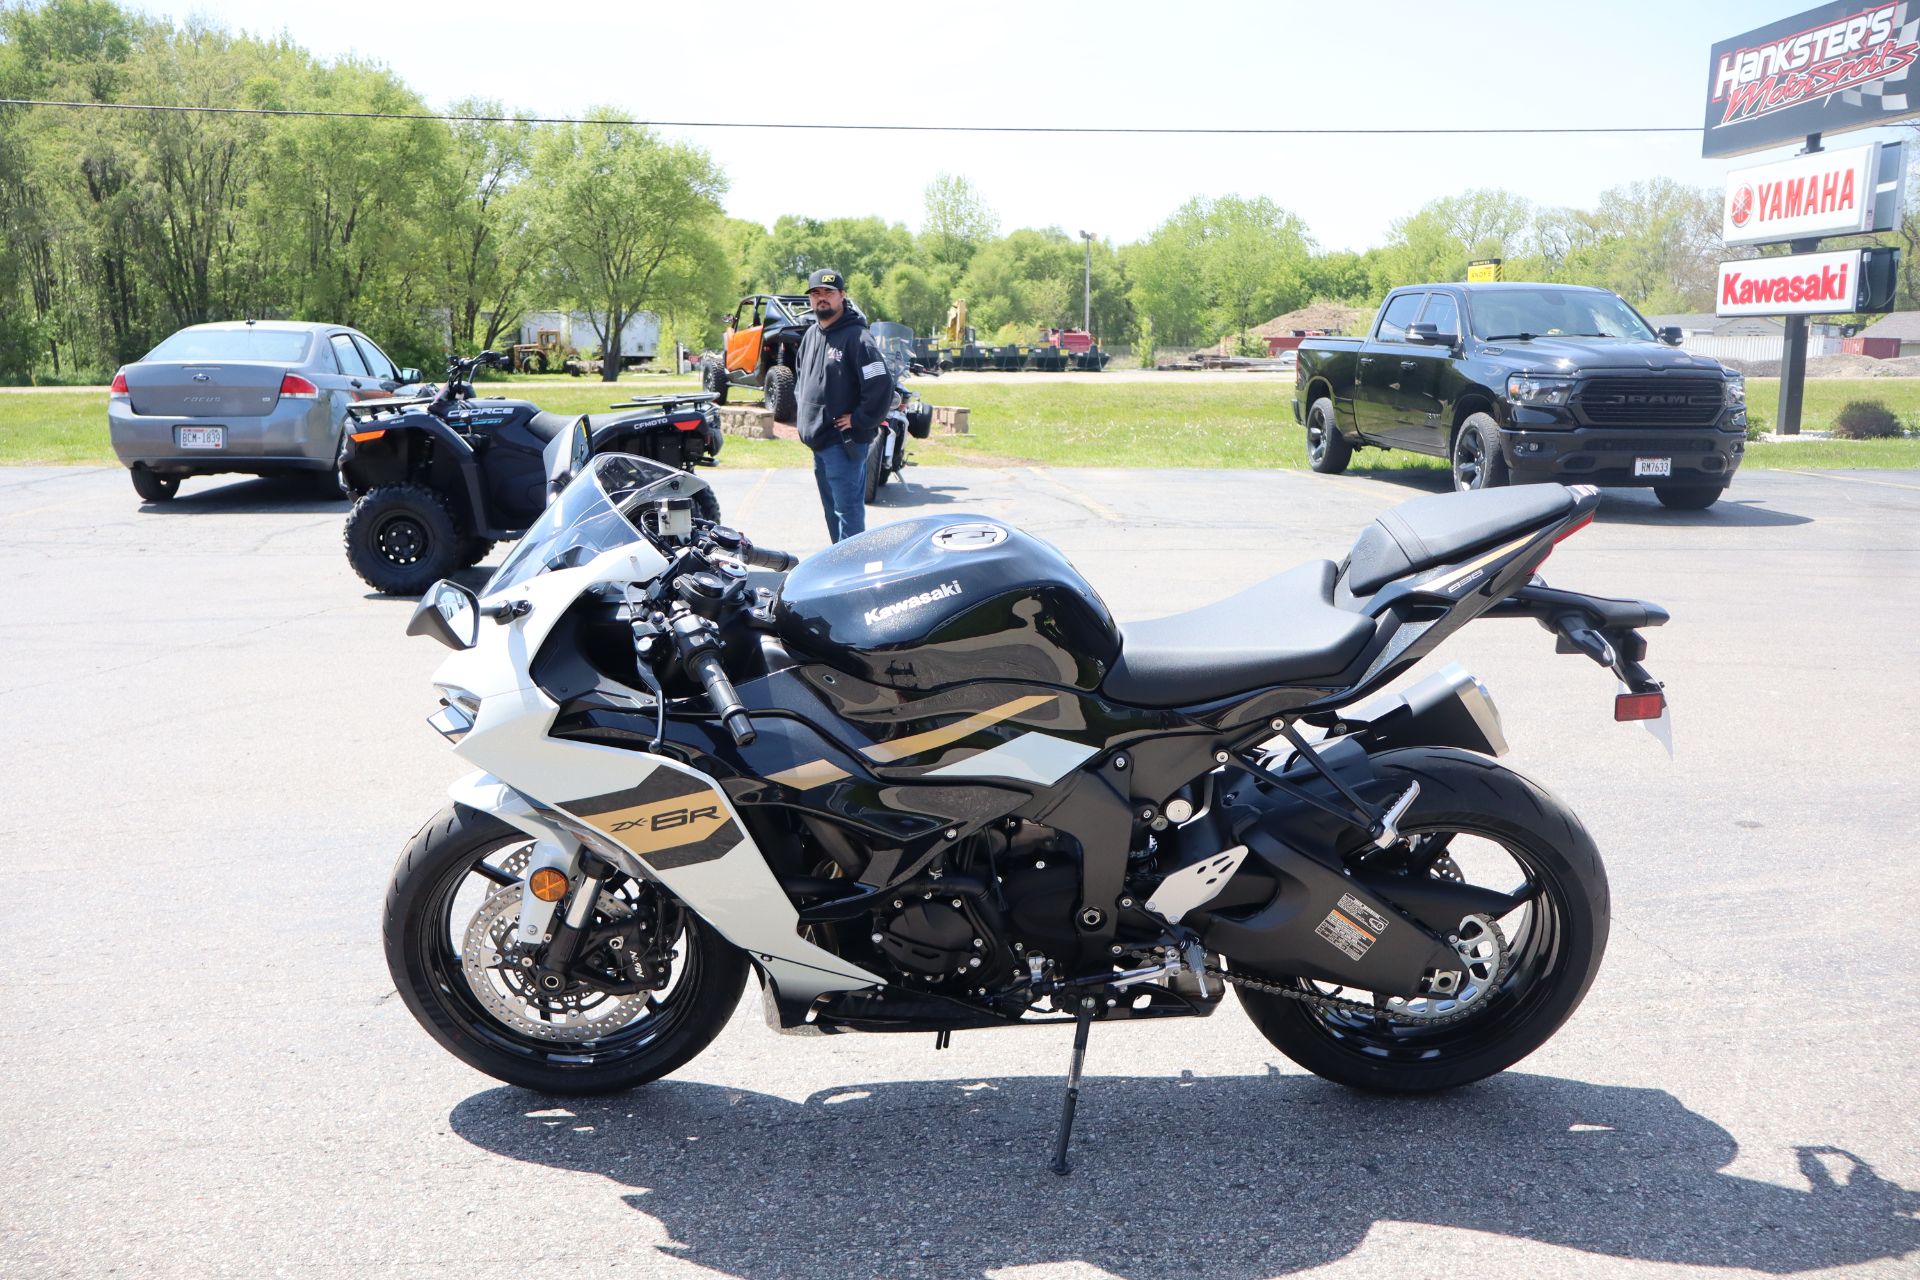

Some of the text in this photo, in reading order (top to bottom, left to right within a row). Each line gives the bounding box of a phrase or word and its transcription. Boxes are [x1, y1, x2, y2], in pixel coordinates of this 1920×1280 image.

[1758, 168, 1855, 222] YAMAHA
[1722, 263, 1848, 305] Kawasaki
[1630, 394, 1685, 405] RAM
[633, 417, 668, 430] CFMOTO
[1641, 462, 1669, 473] RM7633
[864, 580, 962, 625] Kawasaki
[610, 805, 721, 832] ZX-6R
